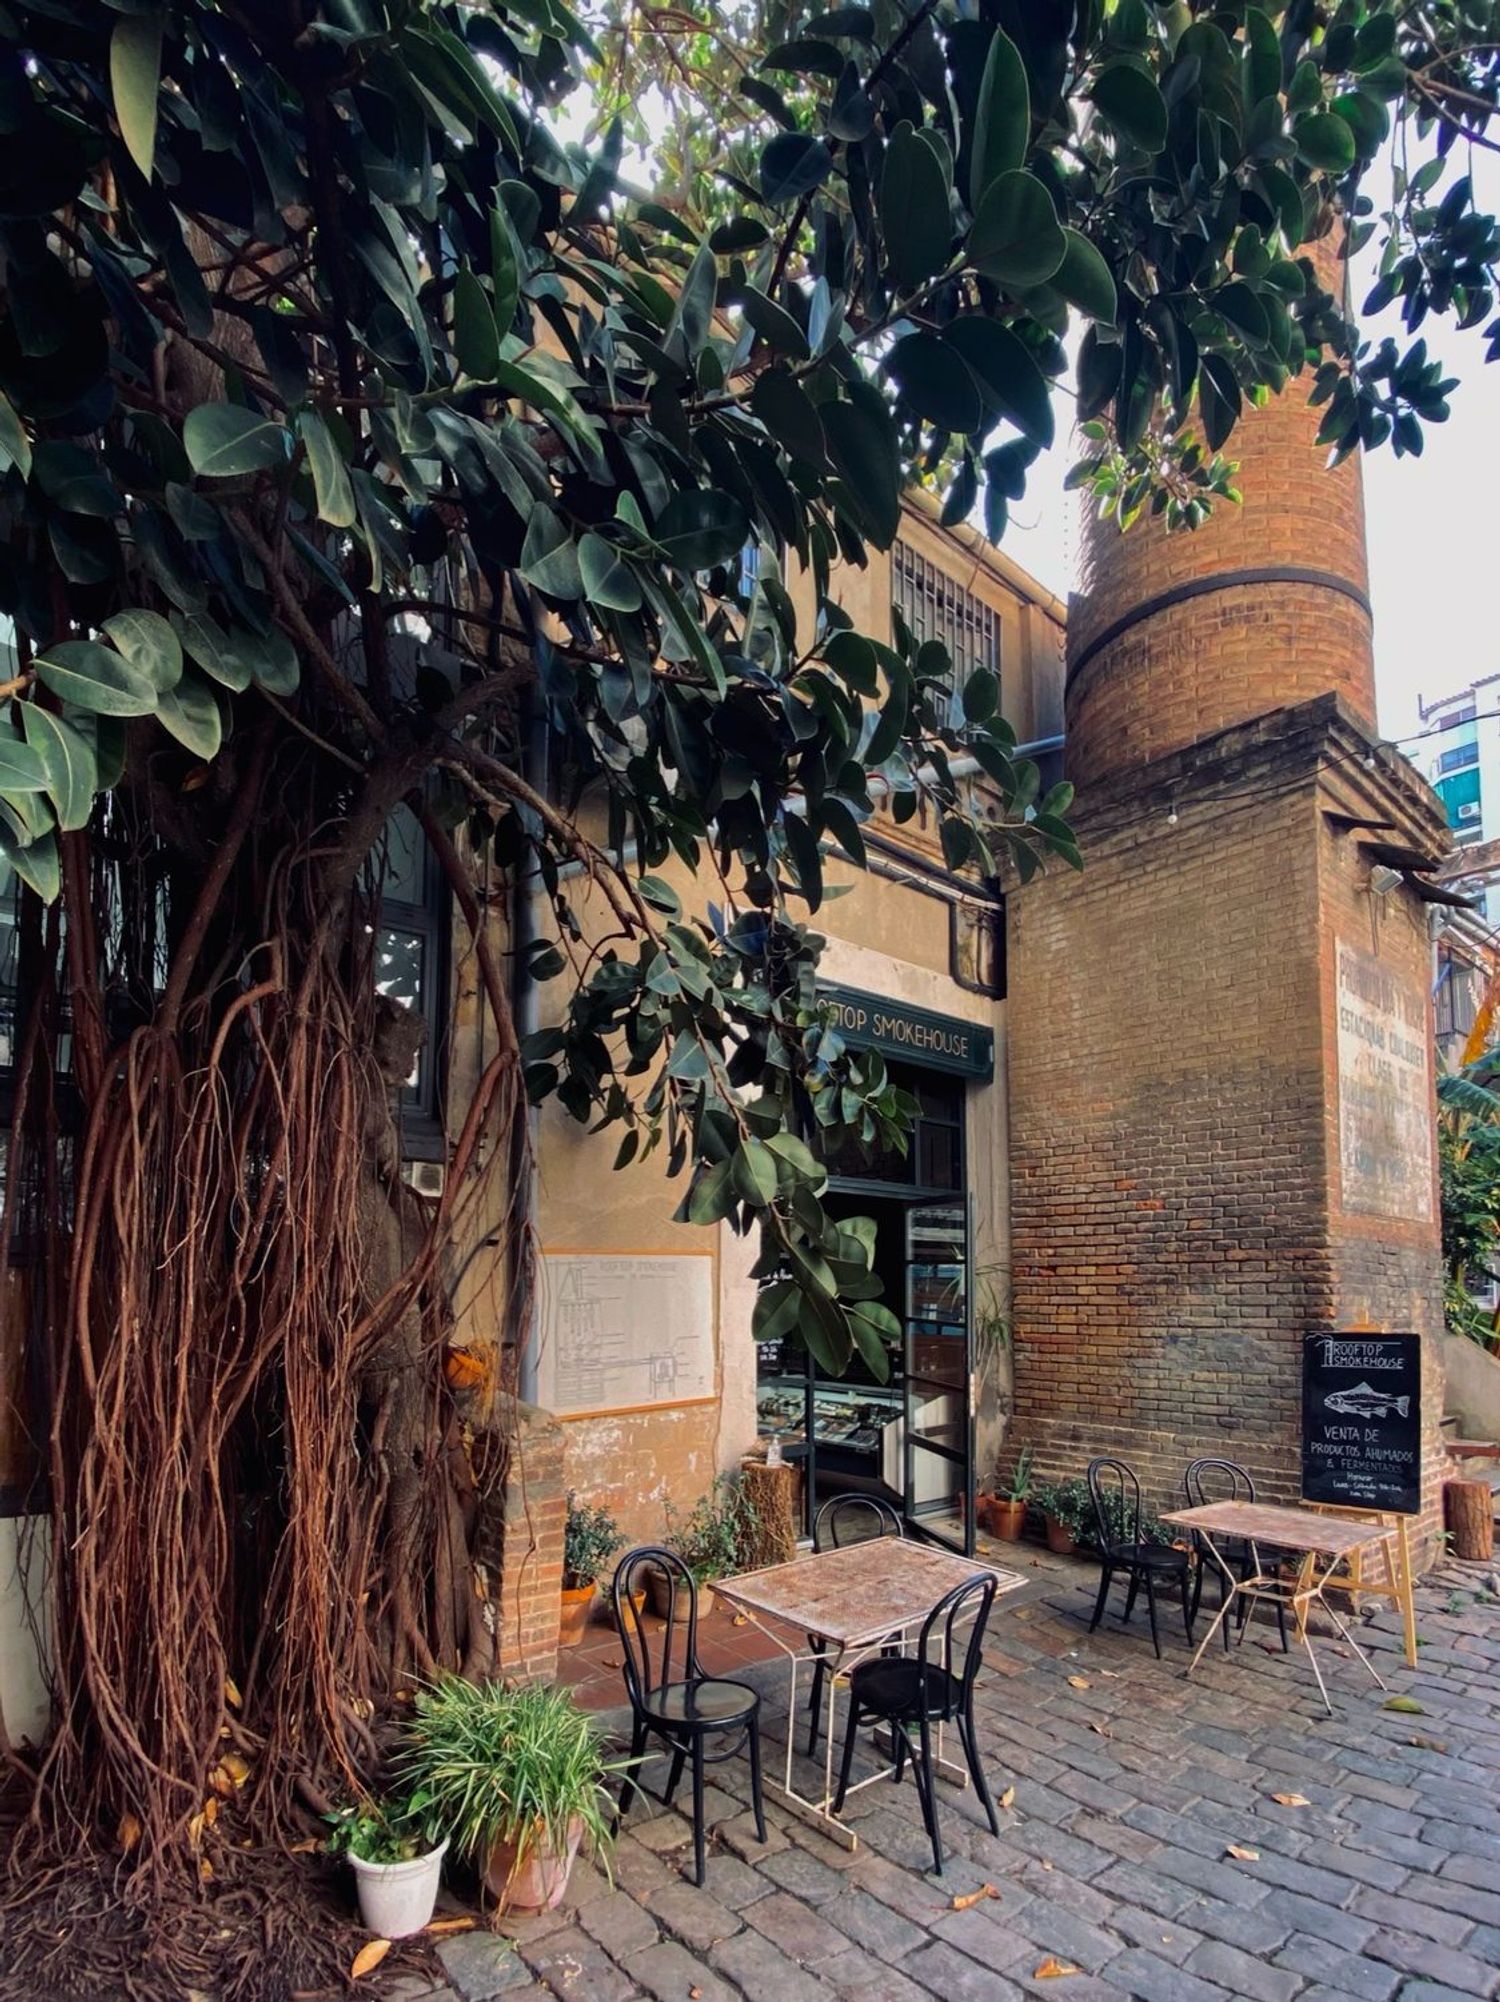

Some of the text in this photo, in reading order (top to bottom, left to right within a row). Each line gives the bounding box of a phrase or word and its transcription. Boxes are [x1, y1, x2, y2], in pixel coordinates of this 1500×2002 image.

[872, 1013, 969, 1058] SMOKEHOUSE
[1333, 1343, 1384, 1356] ROOFTOP
[1333, 1356, 1405, 1369] SMOKEHOUSE
[1323, 1425, 1380, 1443] VENTA DE
[1310, 1441, 1414, 1464] PRODUCTOS AHUMADOS
